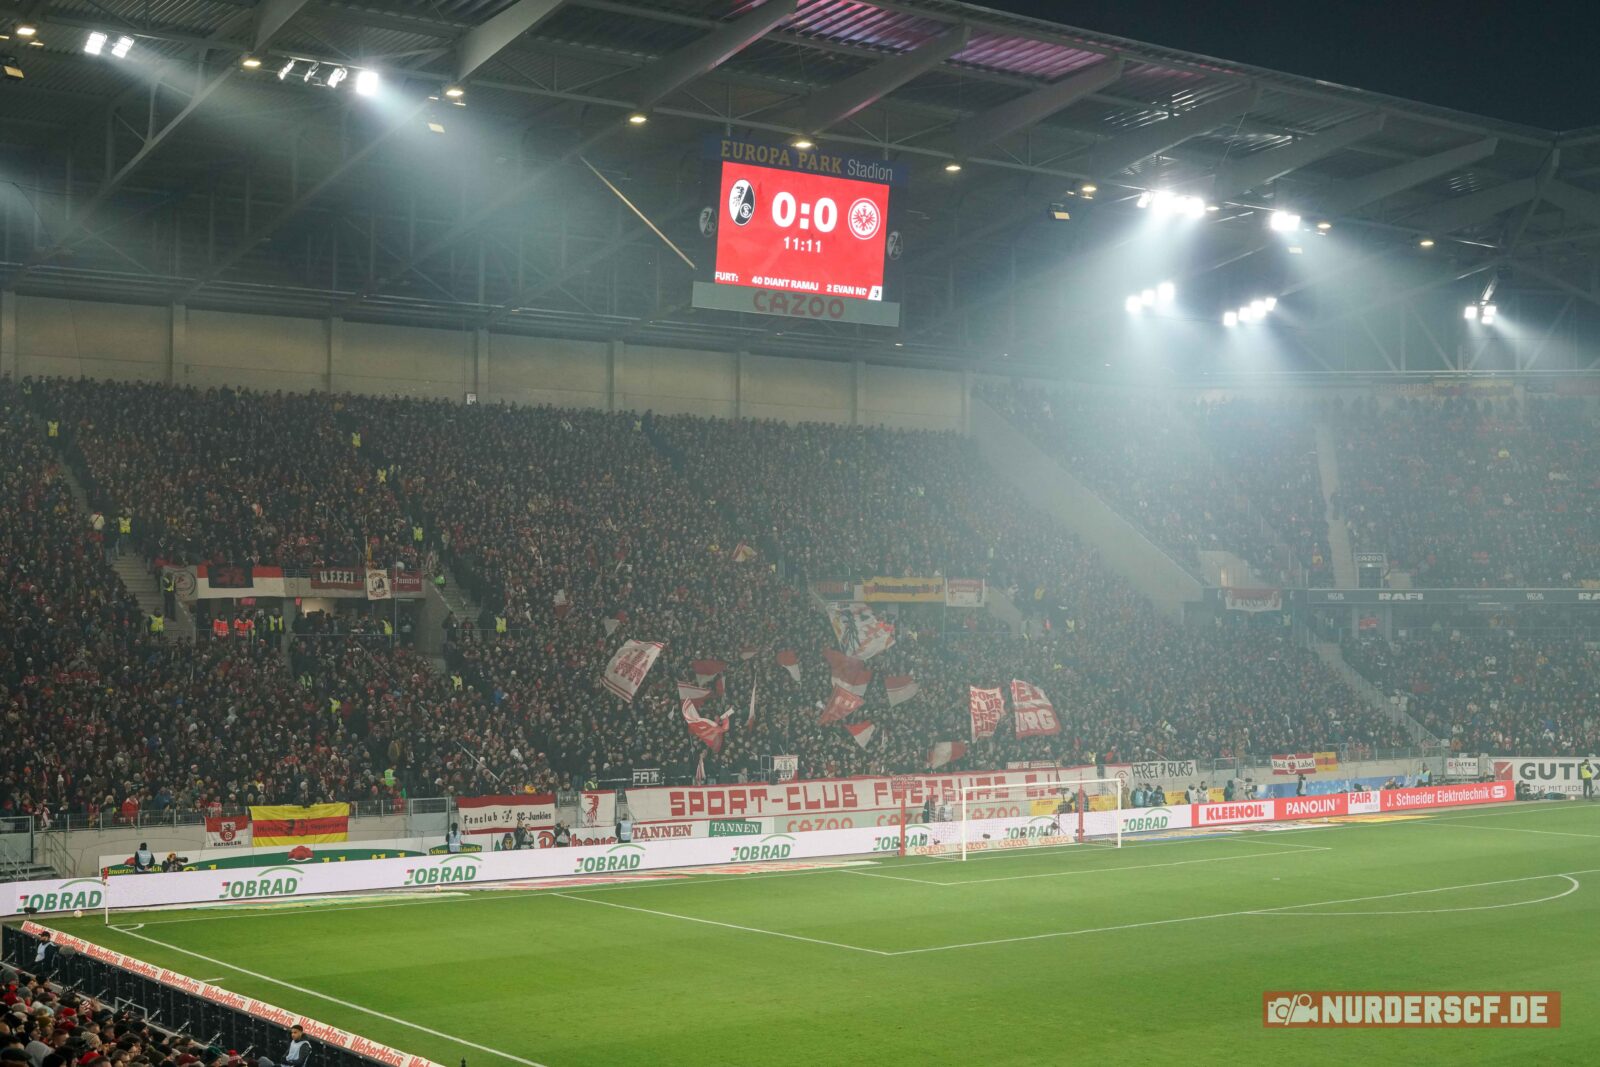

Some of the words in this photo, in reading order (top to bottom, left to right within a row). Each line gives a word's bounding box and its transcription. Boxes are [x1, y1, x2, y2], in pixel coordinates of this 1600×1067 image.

[721, 140, 791, 167] EUROPA
[797, 152, 842, 174] PARK
[847, 158, 893, 181] Stadion
[771, 191, 838, 233] 0:0
[783, 236, 821, 253] 11:11
[752, 275, 763, 285] 40
[764, 277, 790, 288] DIANT
[833, 285, 855, 295] EVAN
[753, 290, 845, 319] CAZOO
[1298, 760, 1315, 768] Label
[669, 783, 858, 817] SPORT-CLUB
[1286, 799, 1336, 815] PANOLIN
[1350, 792, 1371, 804] FAIR
[1386, 794, 1394, 807] J.
[1396, 792, 1435, 806] Schneider
[1437, 787, 1489, 803] Elektrotechnik
[464, 811, 498, 825] Fanclub
[516, 811, 552, 823] SC-Junkies
[1206, 804, 1264, 820] KLEENOIL
[632, 825, 692, 840] TANNEN
[712, 821, 760, 833] TANNEN
[1122, 816, 1168, 833] JOBRAD
[730, 843, 791, 862] JOBRAD
[574, 853, 641, 873] JOBRAD
[404, 865, 477, 885] JOBRAD
[218, 877, 298, 899] JOBRAD
[16, 889, 103, 913] JOBRAD
[202, 985, 246, 1009] WeberHaus
[248, 1000, 295, 1026] WeberHaus
[299, 1016, 348, 1047] WeberHaus
